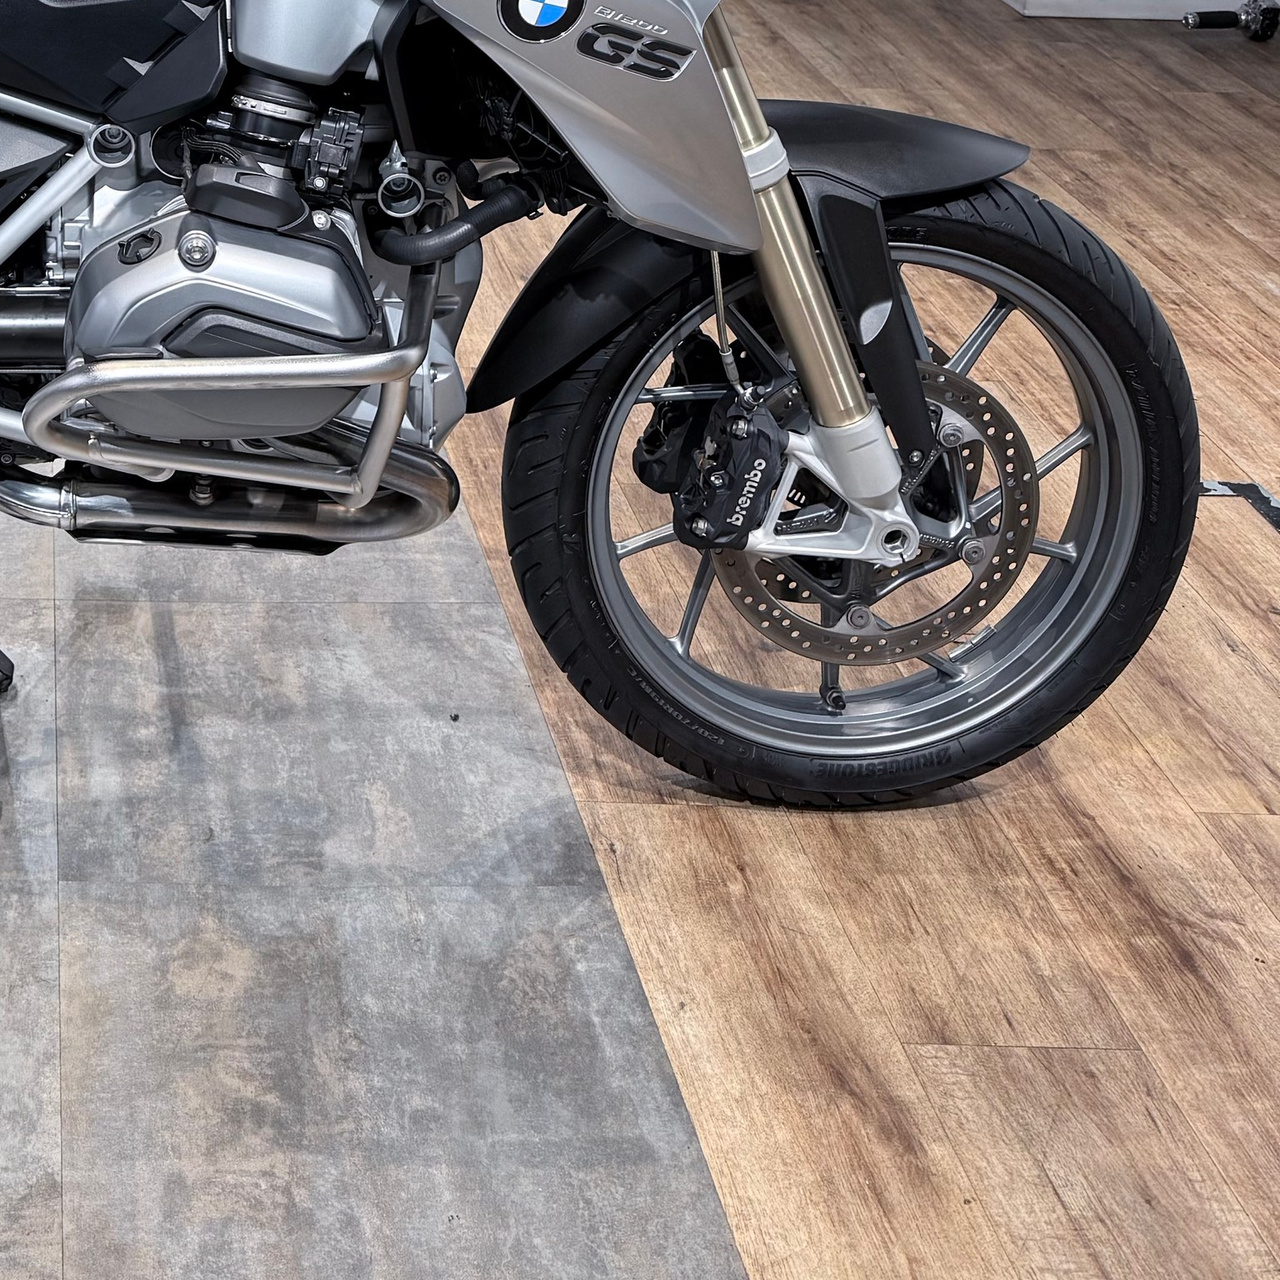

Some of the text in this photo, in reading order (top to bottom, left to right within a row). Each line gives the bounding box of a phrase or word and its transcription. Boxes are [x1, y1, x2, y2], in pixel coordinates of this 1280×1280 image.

[576, 22, 697, 82] GS
[726, 458, 767, 526] brembo
[817, 746, 952, 777] BRIDGESTONE
